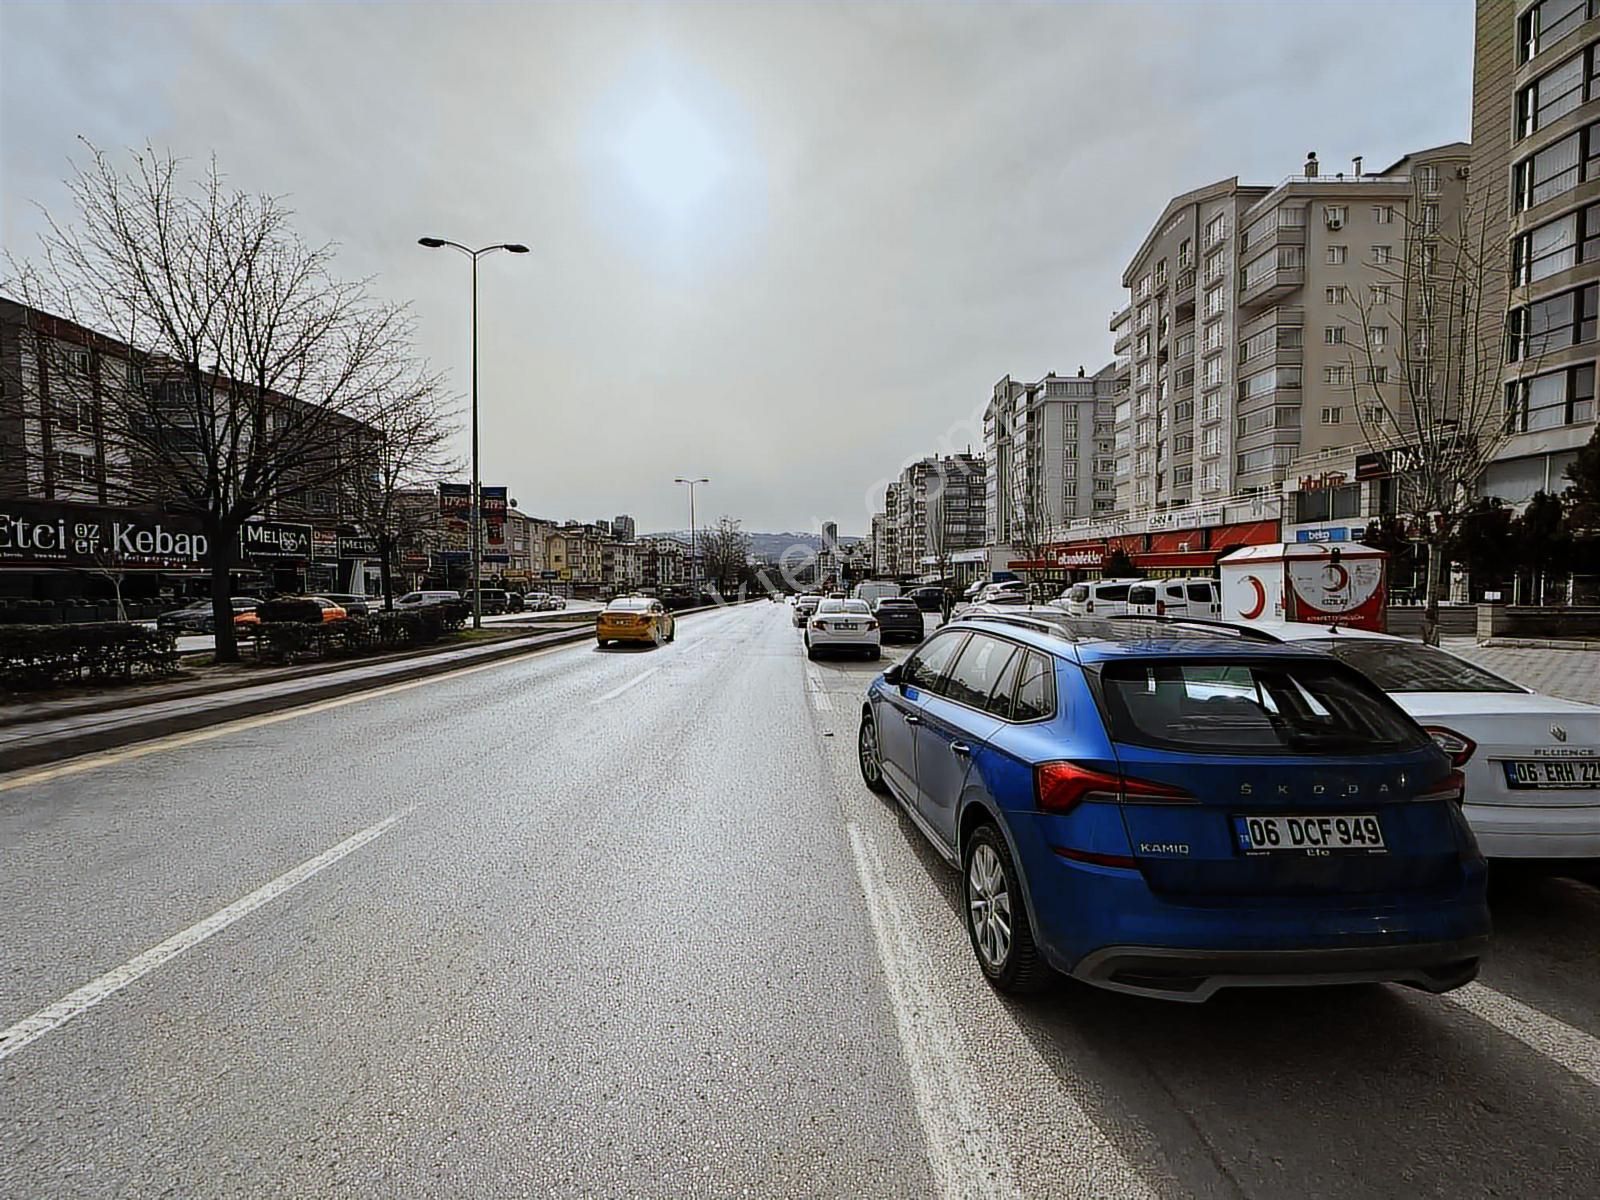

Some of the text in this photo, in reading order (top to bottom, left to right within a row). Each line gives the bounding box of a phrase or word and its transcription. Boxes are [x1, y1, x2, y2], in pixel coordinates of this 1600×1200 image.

[112, 522, 209, 561] Kebap
[1517, 763, 1600, 782] 06 ERH 22
[1248, 818, 1281, 846] 06
[1286, 818, 1332, 846] DCF
[1335, 817, 1382, 845] 949
[1140, 842, 1190, 856] KAMIQ
